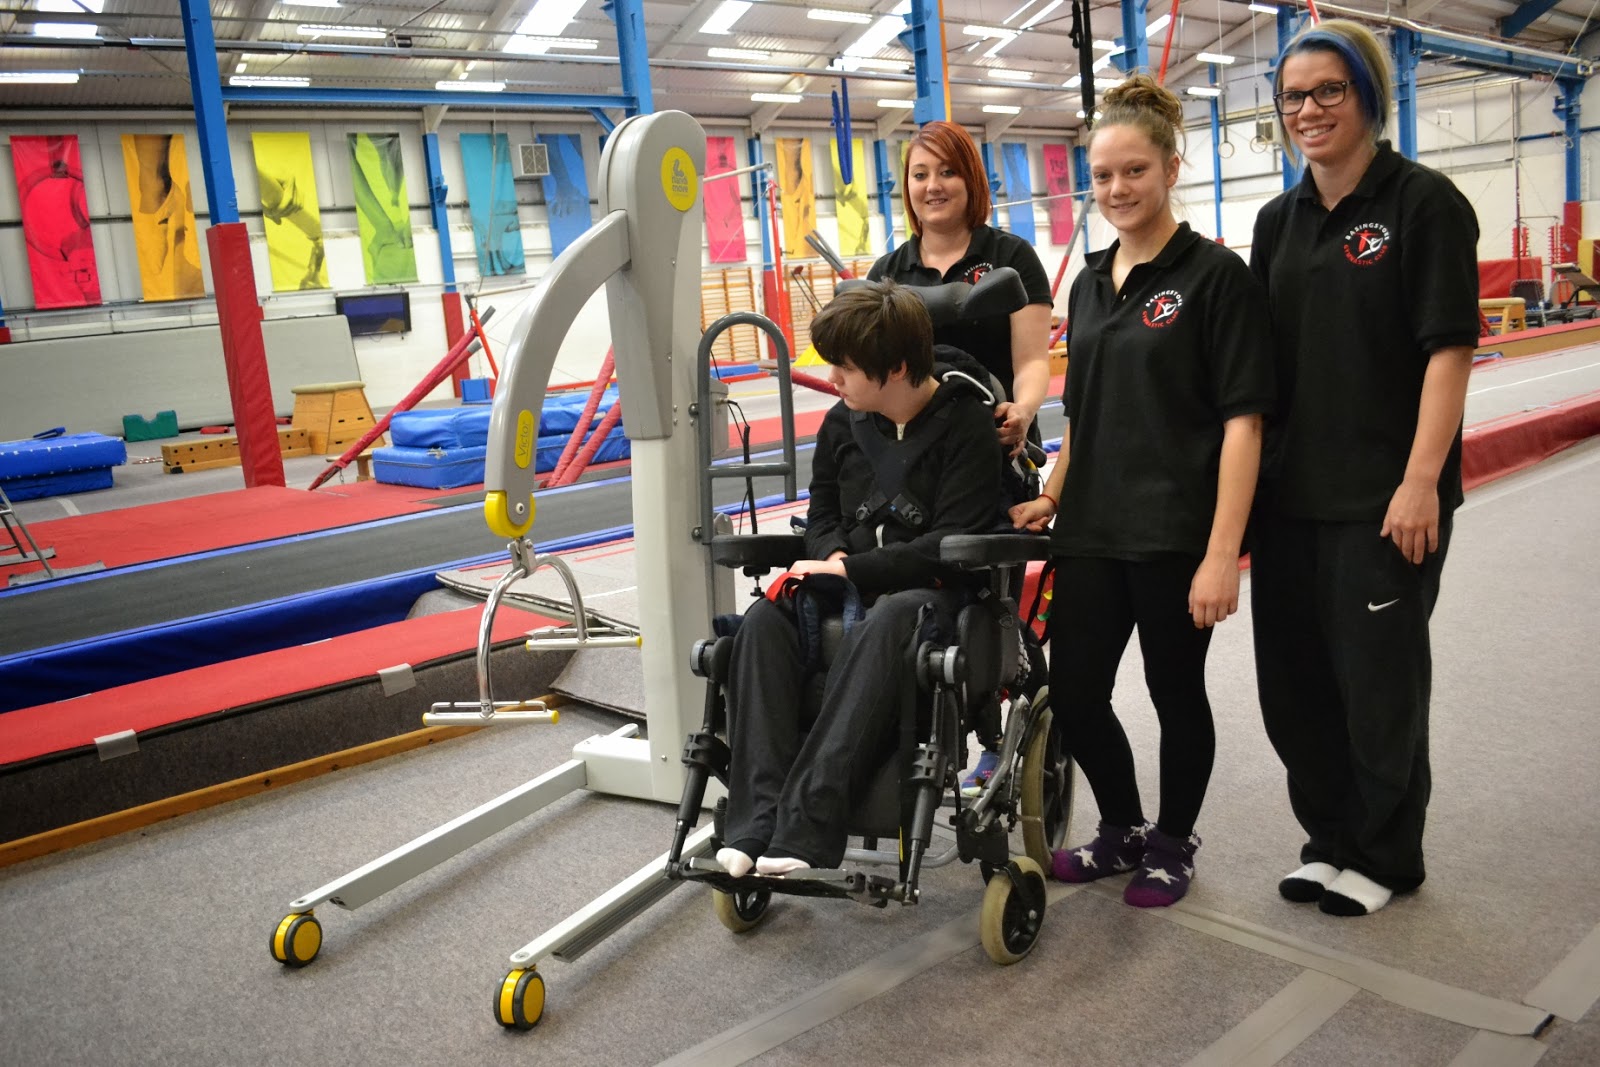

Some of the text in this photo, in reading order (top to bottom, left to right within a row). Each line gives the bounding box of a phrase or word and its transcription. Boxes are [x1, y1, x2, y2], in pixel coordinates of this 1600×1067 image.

[1345, 222, 1390, 241] BASINGSTOKE
[1374, 244, 1388, 261] CLUB
[1165, 310, 1179, 325] CLUB
[517, 421, 529, 457] Victor
